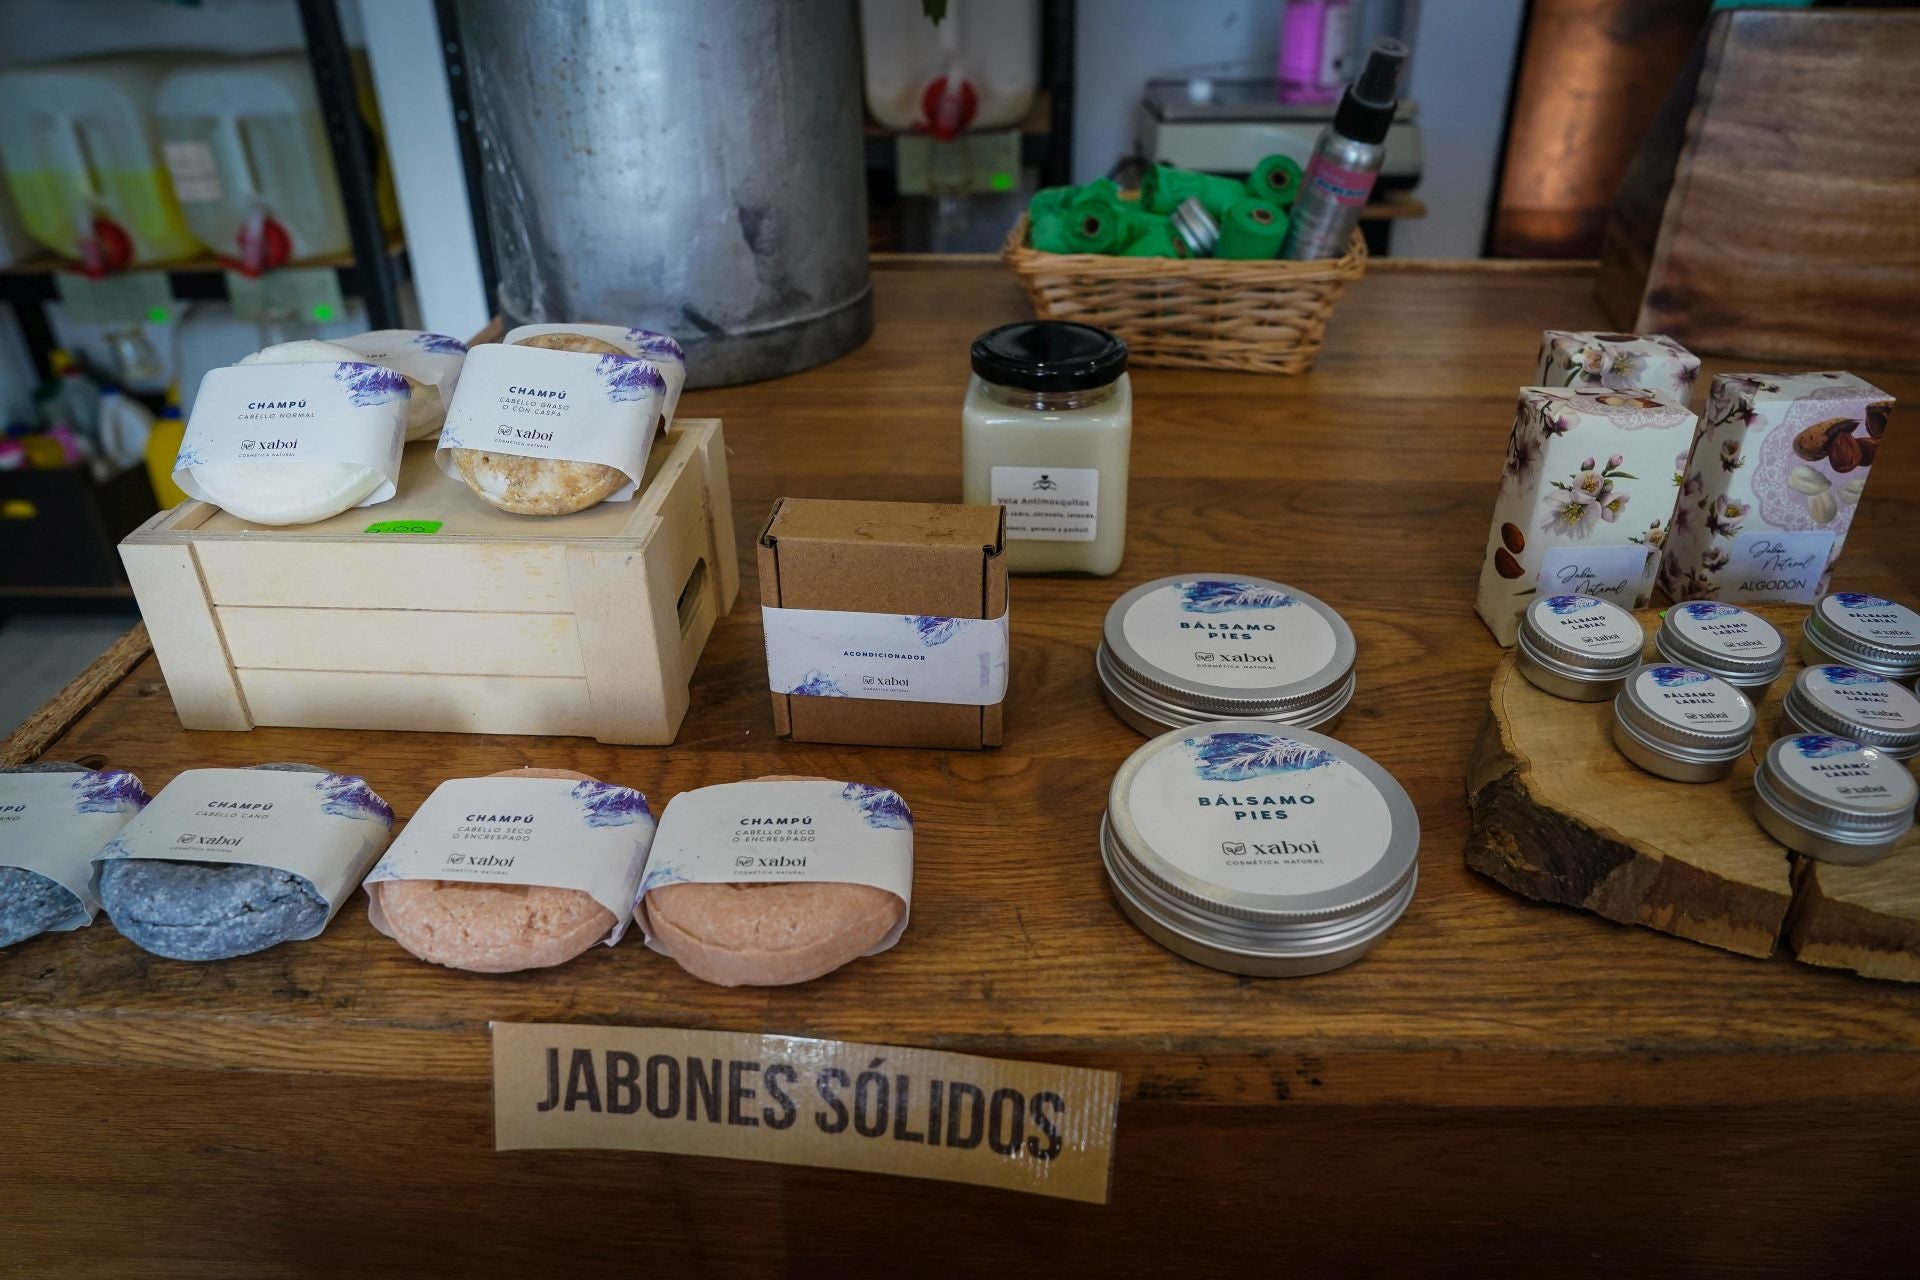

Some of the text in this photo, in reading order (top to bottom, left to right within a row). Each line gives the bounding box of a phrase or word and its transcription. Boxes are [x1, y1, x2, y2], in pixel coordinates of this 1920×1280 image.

[509, 386, 567, 400] CHAMPÚ
[248, 399, 307, 410] CHAMPÚ
[499, 397, 570, 411] CABELLO GRASO
[512, 405, 532, 413] CON
[534, 408, 563, 417] CASPA
[515, 429, 554, 442] xaboi
[258, 438, 298, 450] xaboi
[1739, 578, 1806, 592] ALGODÓN
[1560, 614, 1606, 626] BÁLSAMO
[1180, 621, 1276, 631] BÁLSAMO
[1571, 622, 1606, 630] LABIAL
[1701, 623, 1748, 631] BÁLSAMO
[1208, 632, 1252, 640] PIES
[1713, 628, 1748, 636] LABIAL
[843, 651, 927, 661] ACONDICIONADOR
[1220, 653, 1274, 663] xaboi
[877, 676, 909, 686] xaboi
[1824, 770, 1870, 778] LABIAL
[1198, 795, 1315, 806] BÁLSAMO
[208, 801, 274, 811] CHAMPÚ
[466, 814, 535, 824] CHAMPÚ
[1234, 810, 1289, 820] PIES
[740, 816, 813, 825] CHAMPÚ
[195, 835, 244, 847] xaboi
[464, 833, 530, 842] ENCRESPADO
[1252, 840, 1320, 855] xaboi
[467, 855, 515, 867] xaboi
[759, 856, 807, 867] xaboi
[537, 1047, 1066, 1160] JABONES SÓLIDOS
